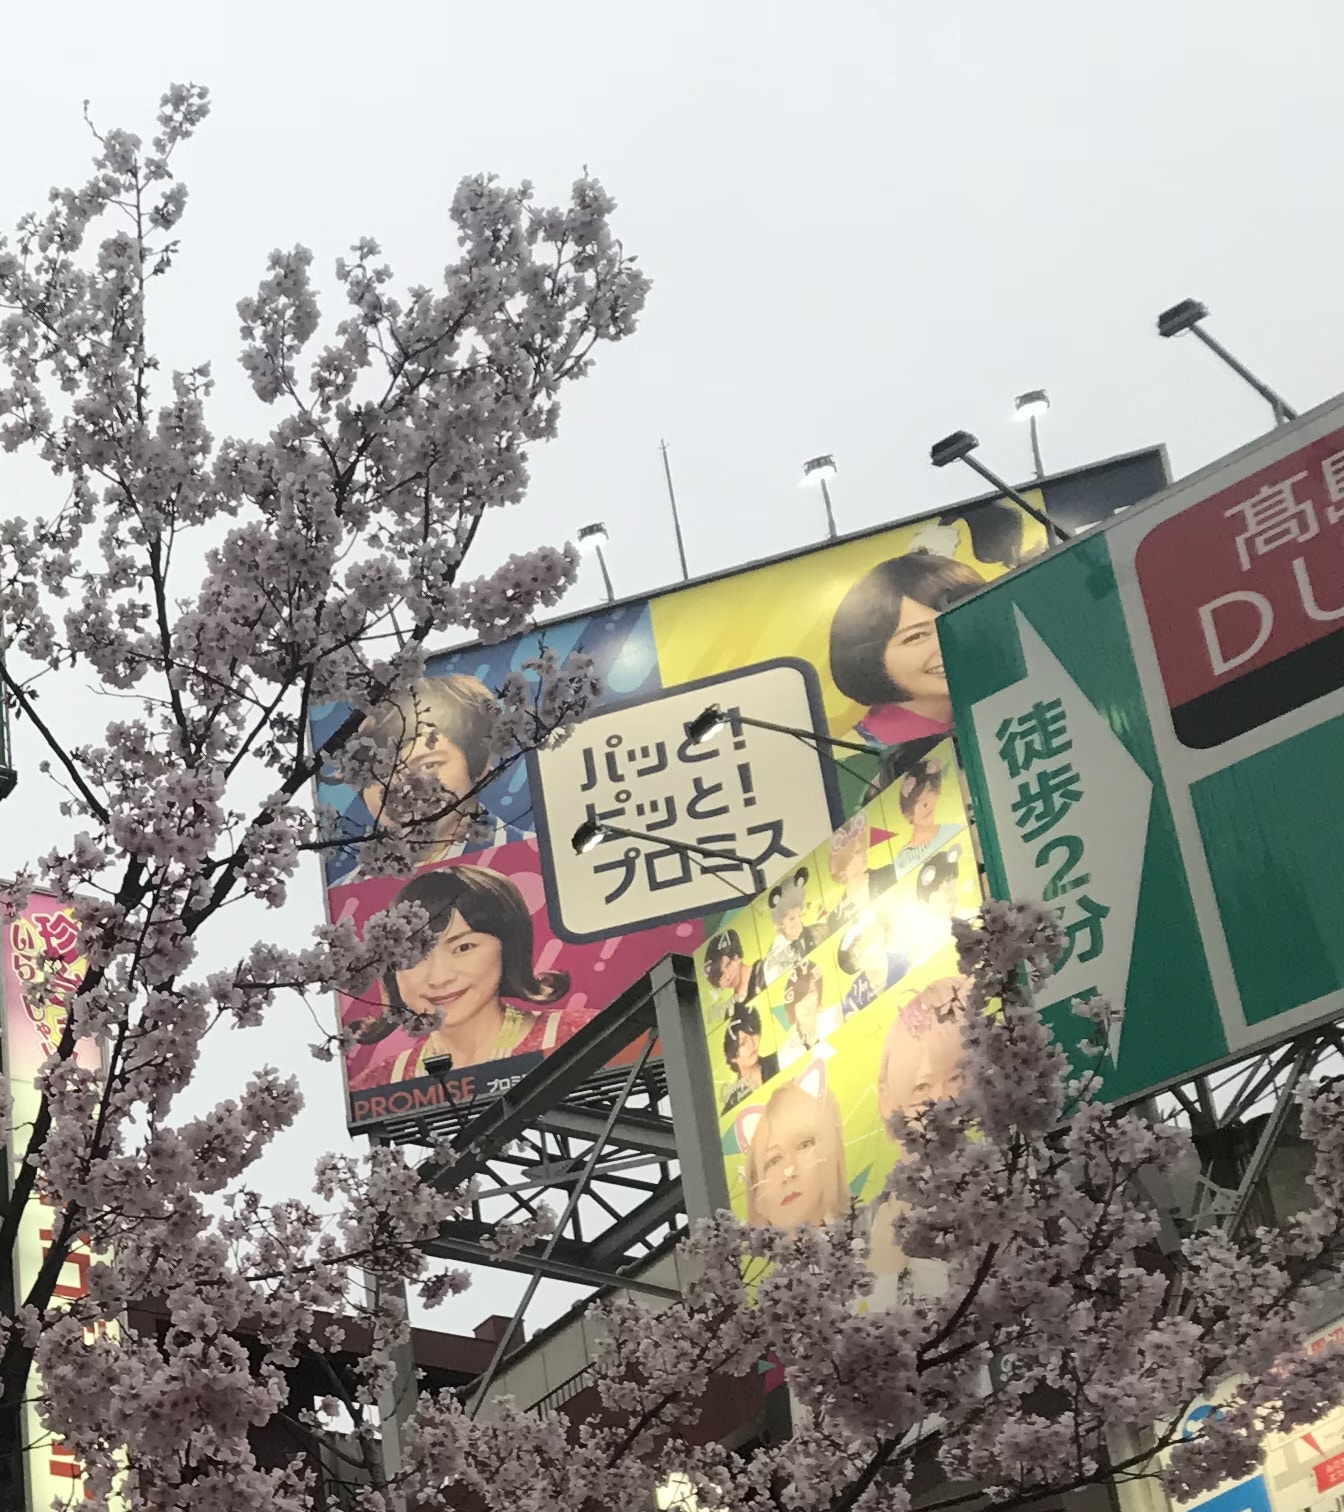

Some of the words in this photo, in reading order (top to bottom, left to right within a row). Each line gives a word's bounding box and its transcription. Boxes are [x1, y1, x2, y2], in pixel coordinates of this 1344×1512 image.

[580, 705, 748, 793] パッと!
[584, 762, 757, 832] ピッと!
[994, 697, 1112, 968] 徒歩2分
[593, 818, 799, 904] プロミス
[353, 1076, 477, 1122] PROMISE
